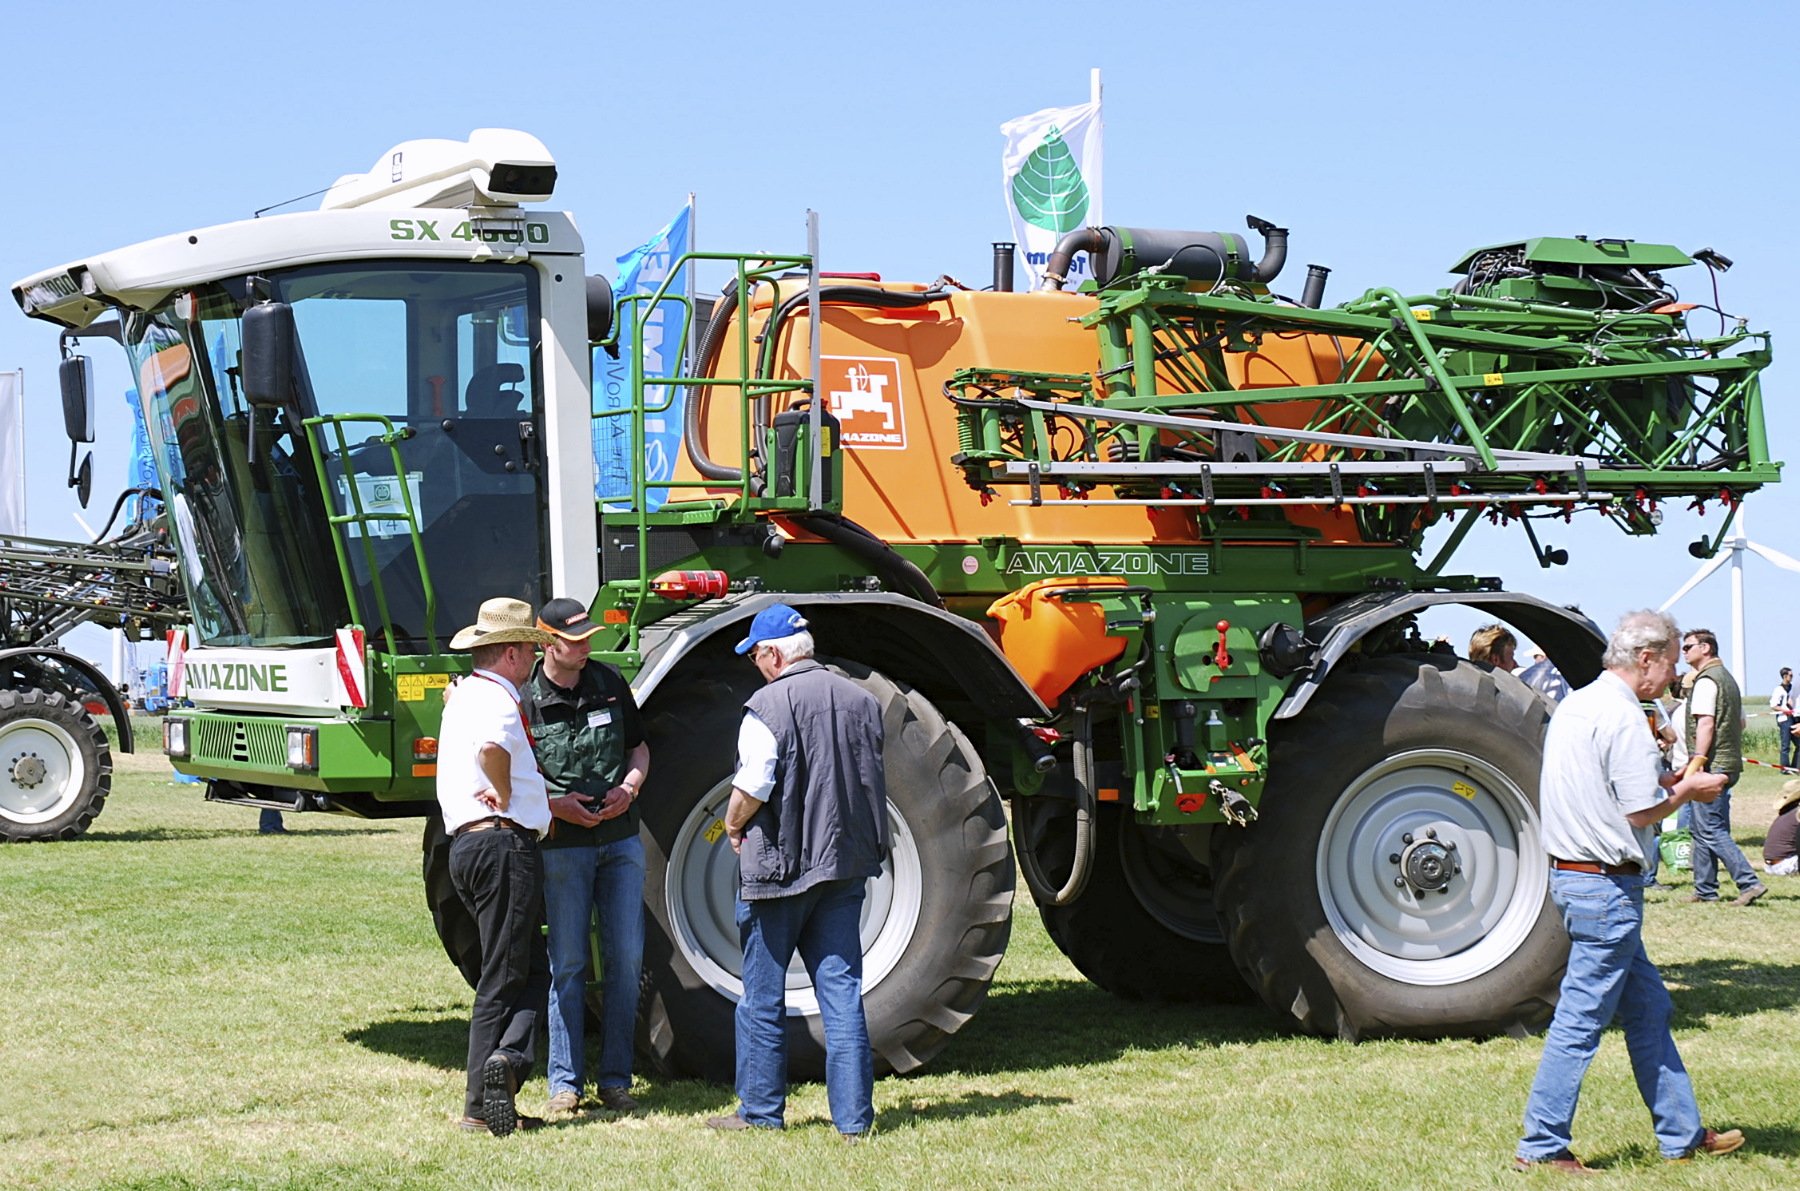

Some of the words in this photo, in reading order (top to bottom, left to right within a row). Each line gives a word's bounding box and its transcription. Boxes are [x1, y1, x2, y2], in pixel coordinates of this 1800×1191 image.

[390, 219, 440, 241] SX
[840, 433, 902, 443] MAZONE
[1006, 552, 1209, 575] AMAZONE
